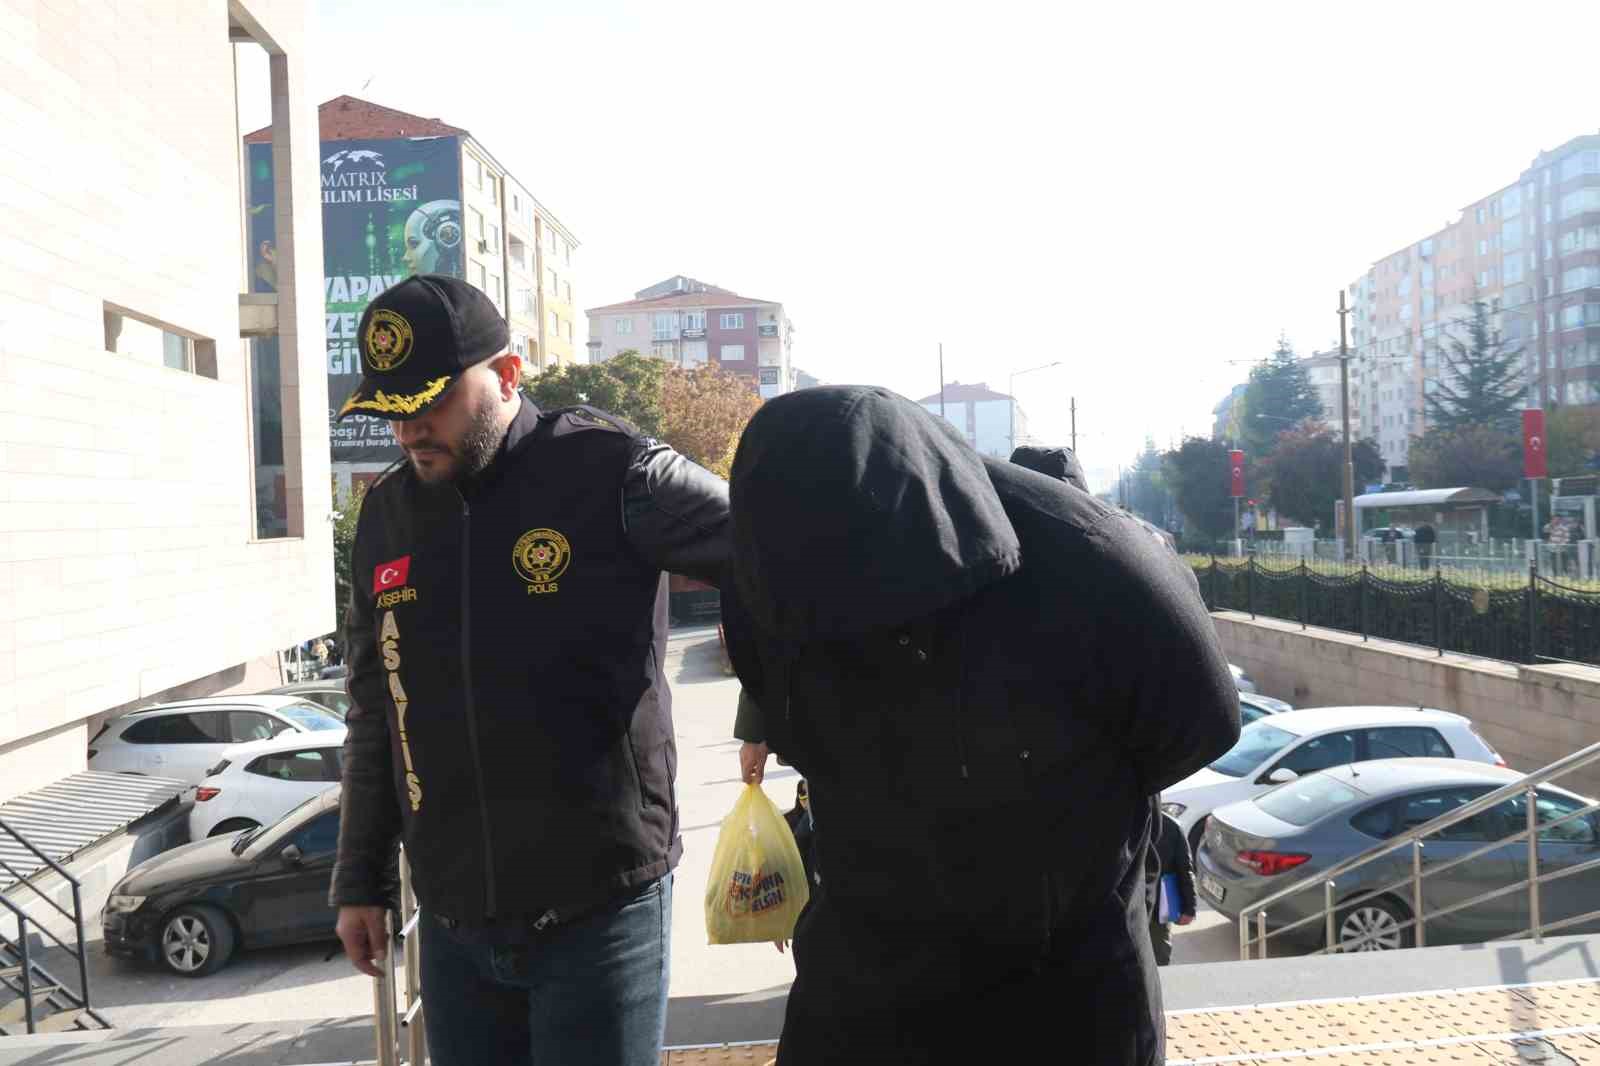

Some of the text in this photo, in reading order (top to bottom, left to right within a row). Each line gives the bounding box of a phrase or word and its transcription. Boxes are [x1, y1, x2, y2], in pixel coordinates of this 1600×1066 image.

[320, 172, 387, 187] MATRIX
[320, 185, 417, 203] ILIM LİSESİ
